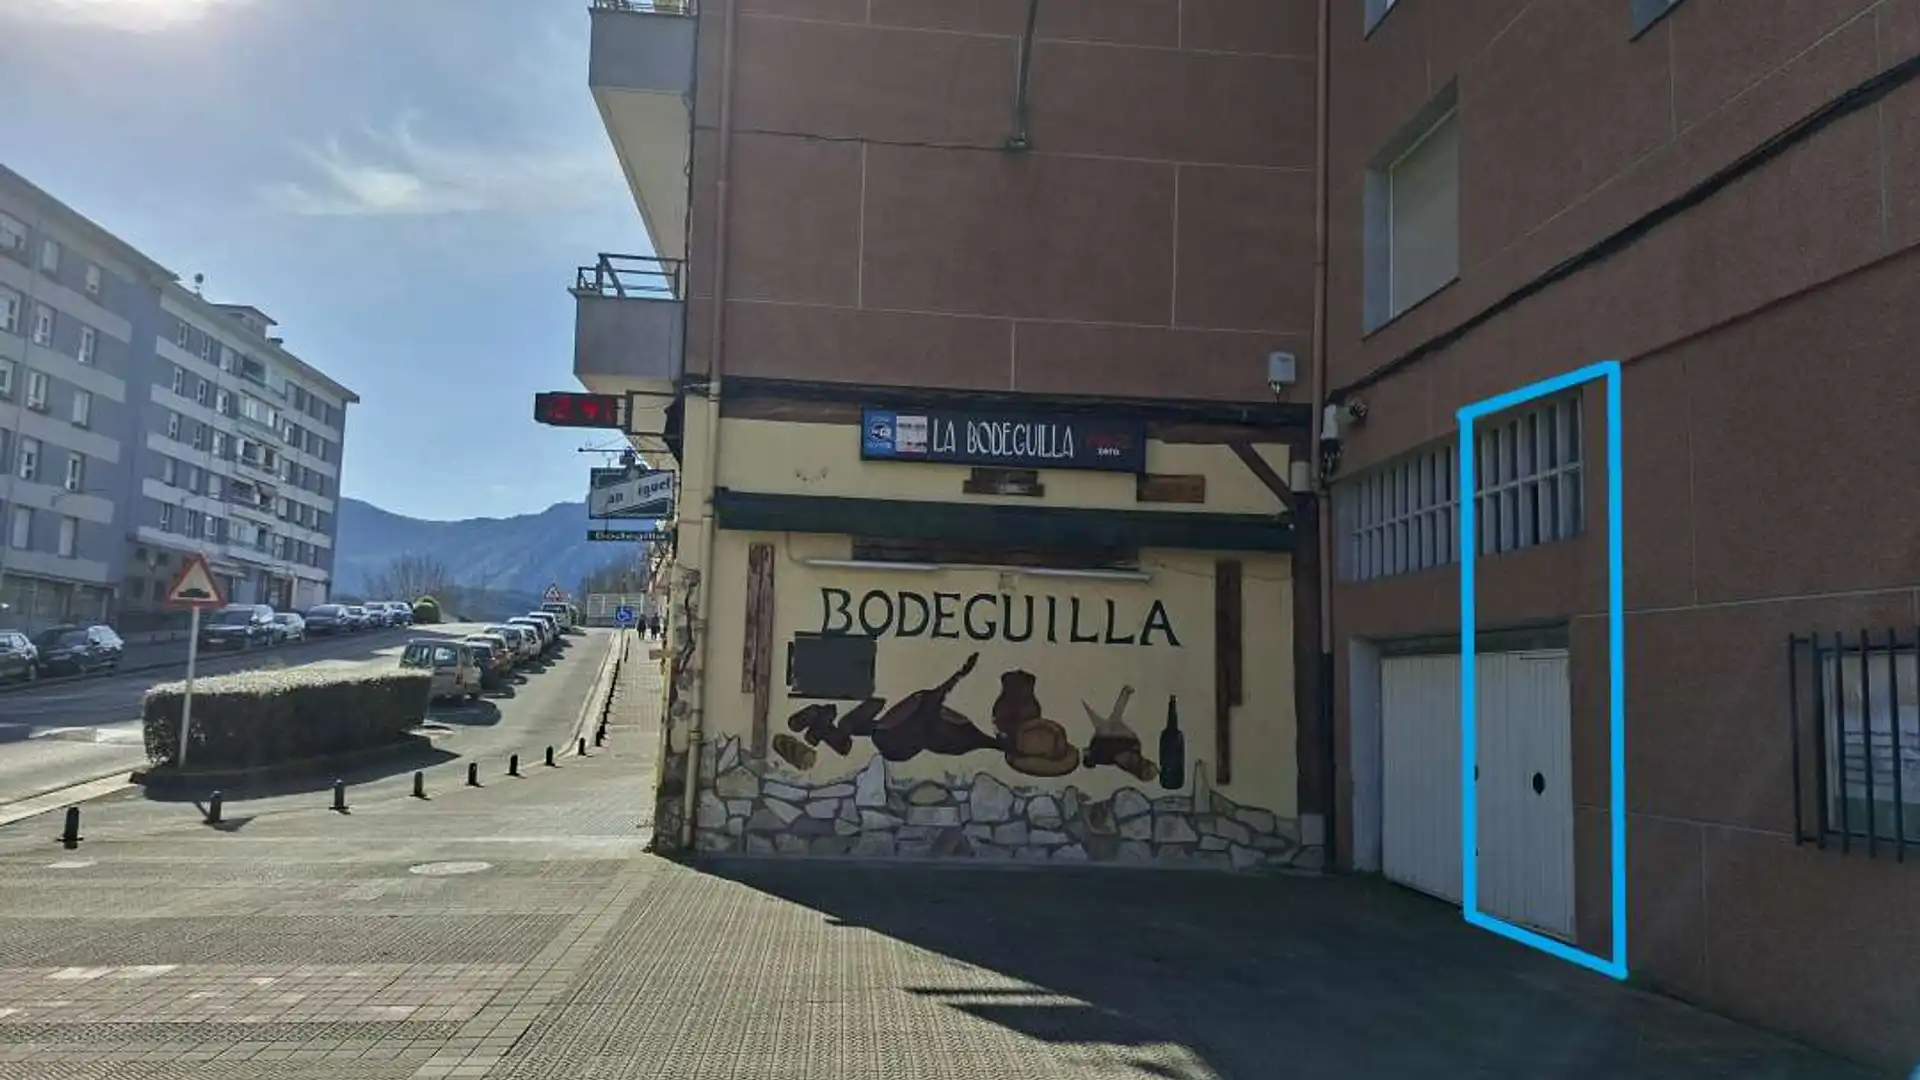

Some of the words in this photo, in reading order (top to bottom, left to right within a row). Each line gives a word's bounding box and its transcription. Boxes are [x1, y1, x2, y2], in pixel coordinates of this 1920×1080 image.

[932, 418, 956, 453] LA
[966, 418, 1075, 458] BODEGUILLA
[821, 587, 1181, 647] BODEGUILLA
